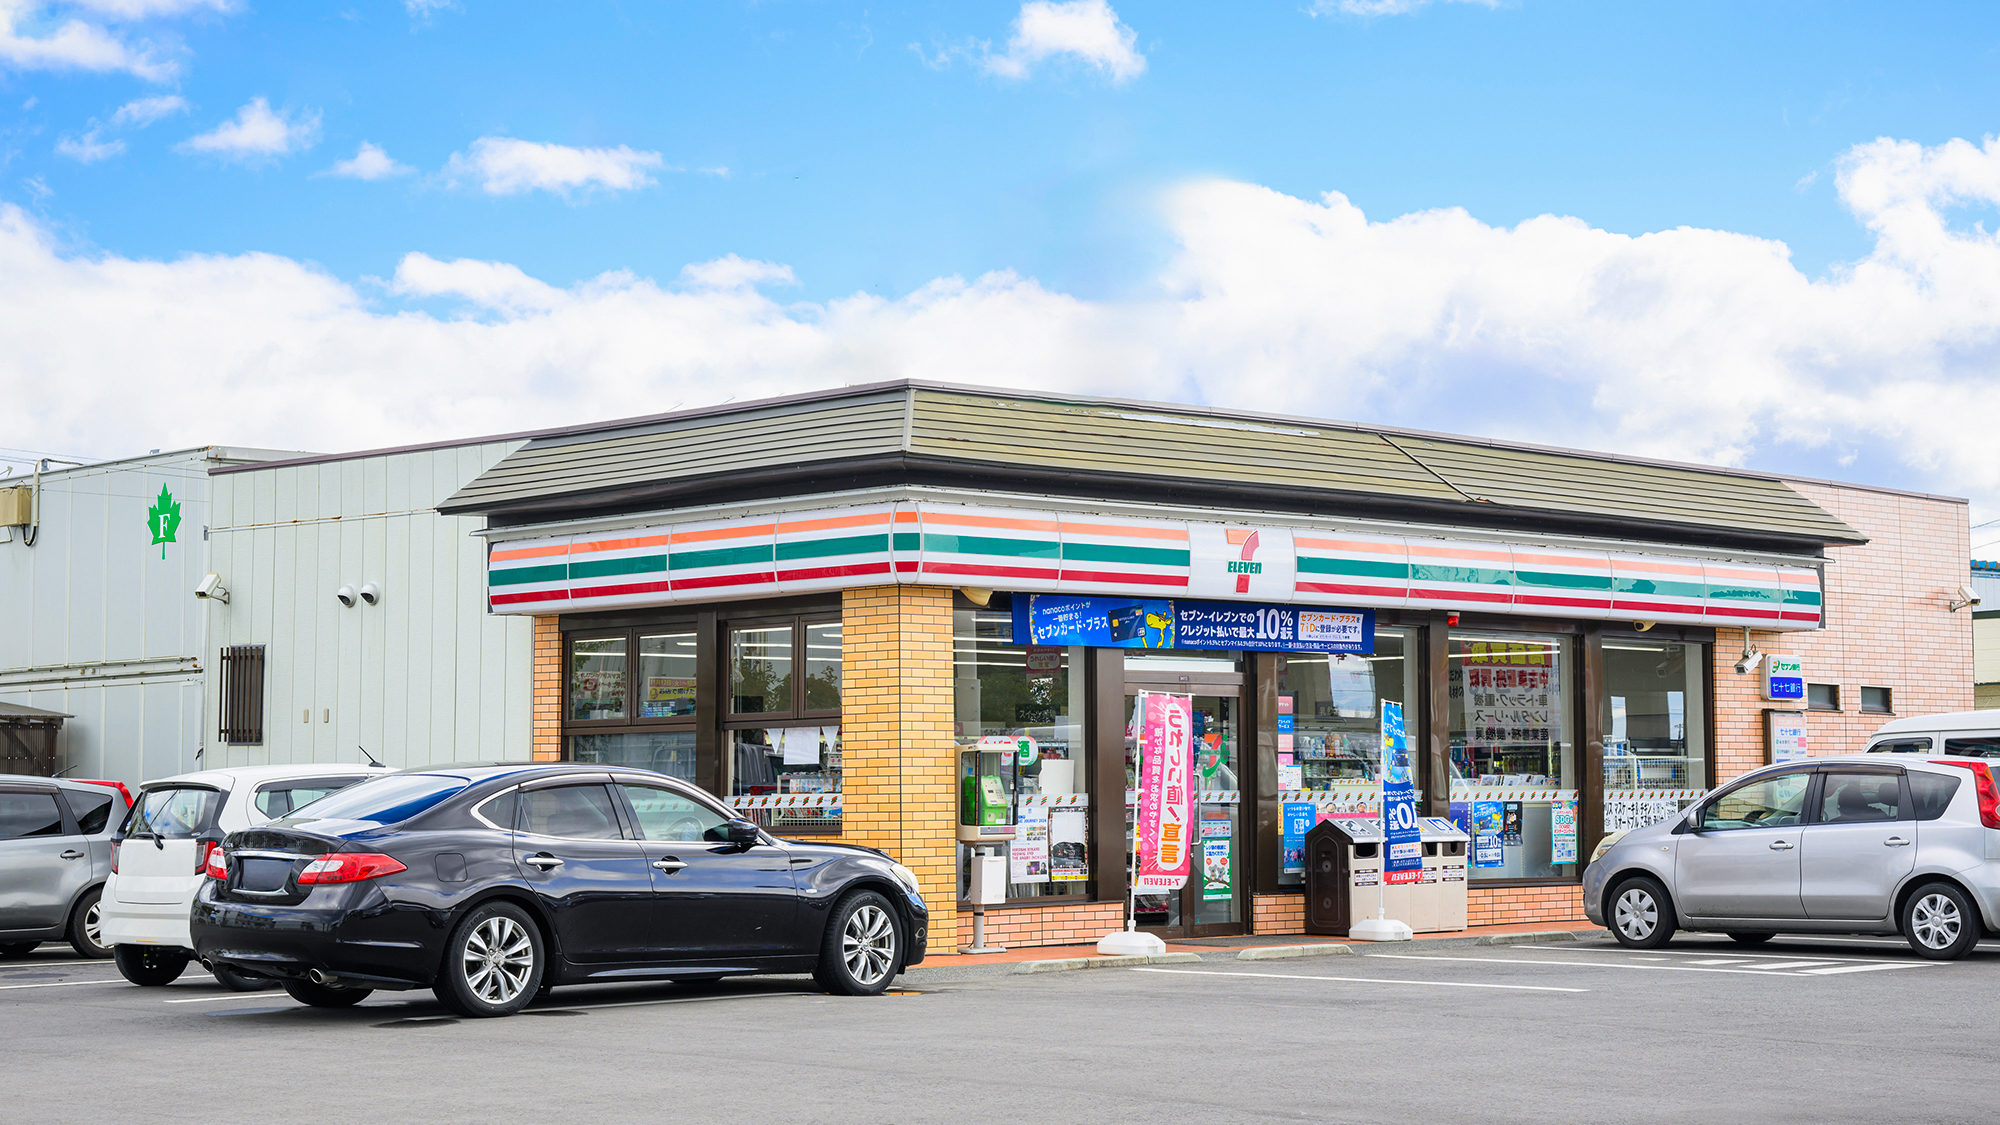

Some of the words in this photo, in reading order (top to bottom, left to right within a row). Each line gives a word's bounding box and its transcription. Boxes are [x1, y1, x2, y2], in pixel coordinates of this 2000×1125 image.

[158, 513, 171, 539] F
[1042, 601, 1091, 615] nanacoポイントが
[1037, 616, 1109, 640] セブンカード・プラス
[1772, 682, 1801, 693] 七十七銀行
[1780, 728, 1801, 736] 七十七銀行
[460, 912, 483, 941] DUNLOP
